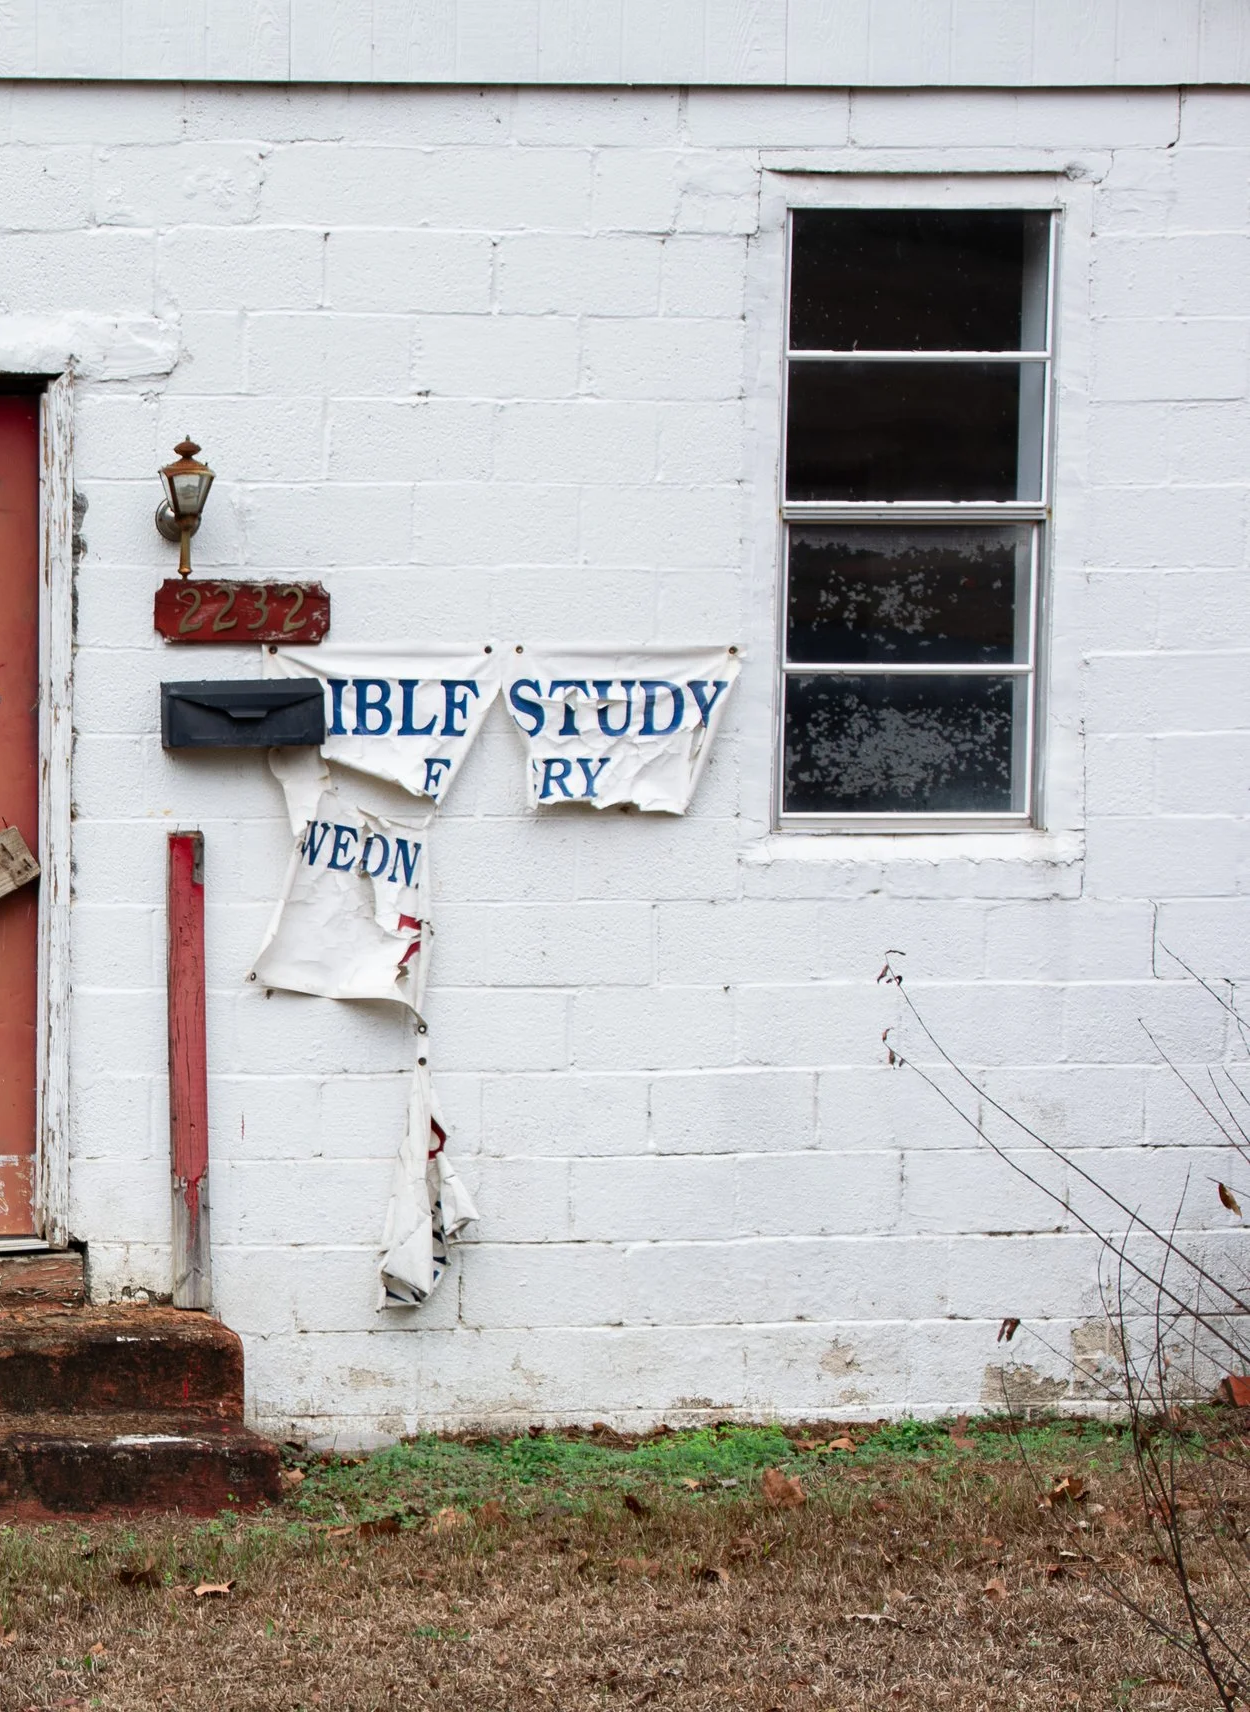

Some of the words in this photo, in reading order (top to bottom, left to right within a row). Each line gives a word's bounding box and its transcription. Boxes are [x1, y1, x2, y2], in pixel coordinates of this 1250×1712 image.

[178, 586, 307, 635] 2232
[326, 678, 481, 737] IBLE
[509, 678, 729, 739] STUDY
[300, 820, 423, 890] WEDN
